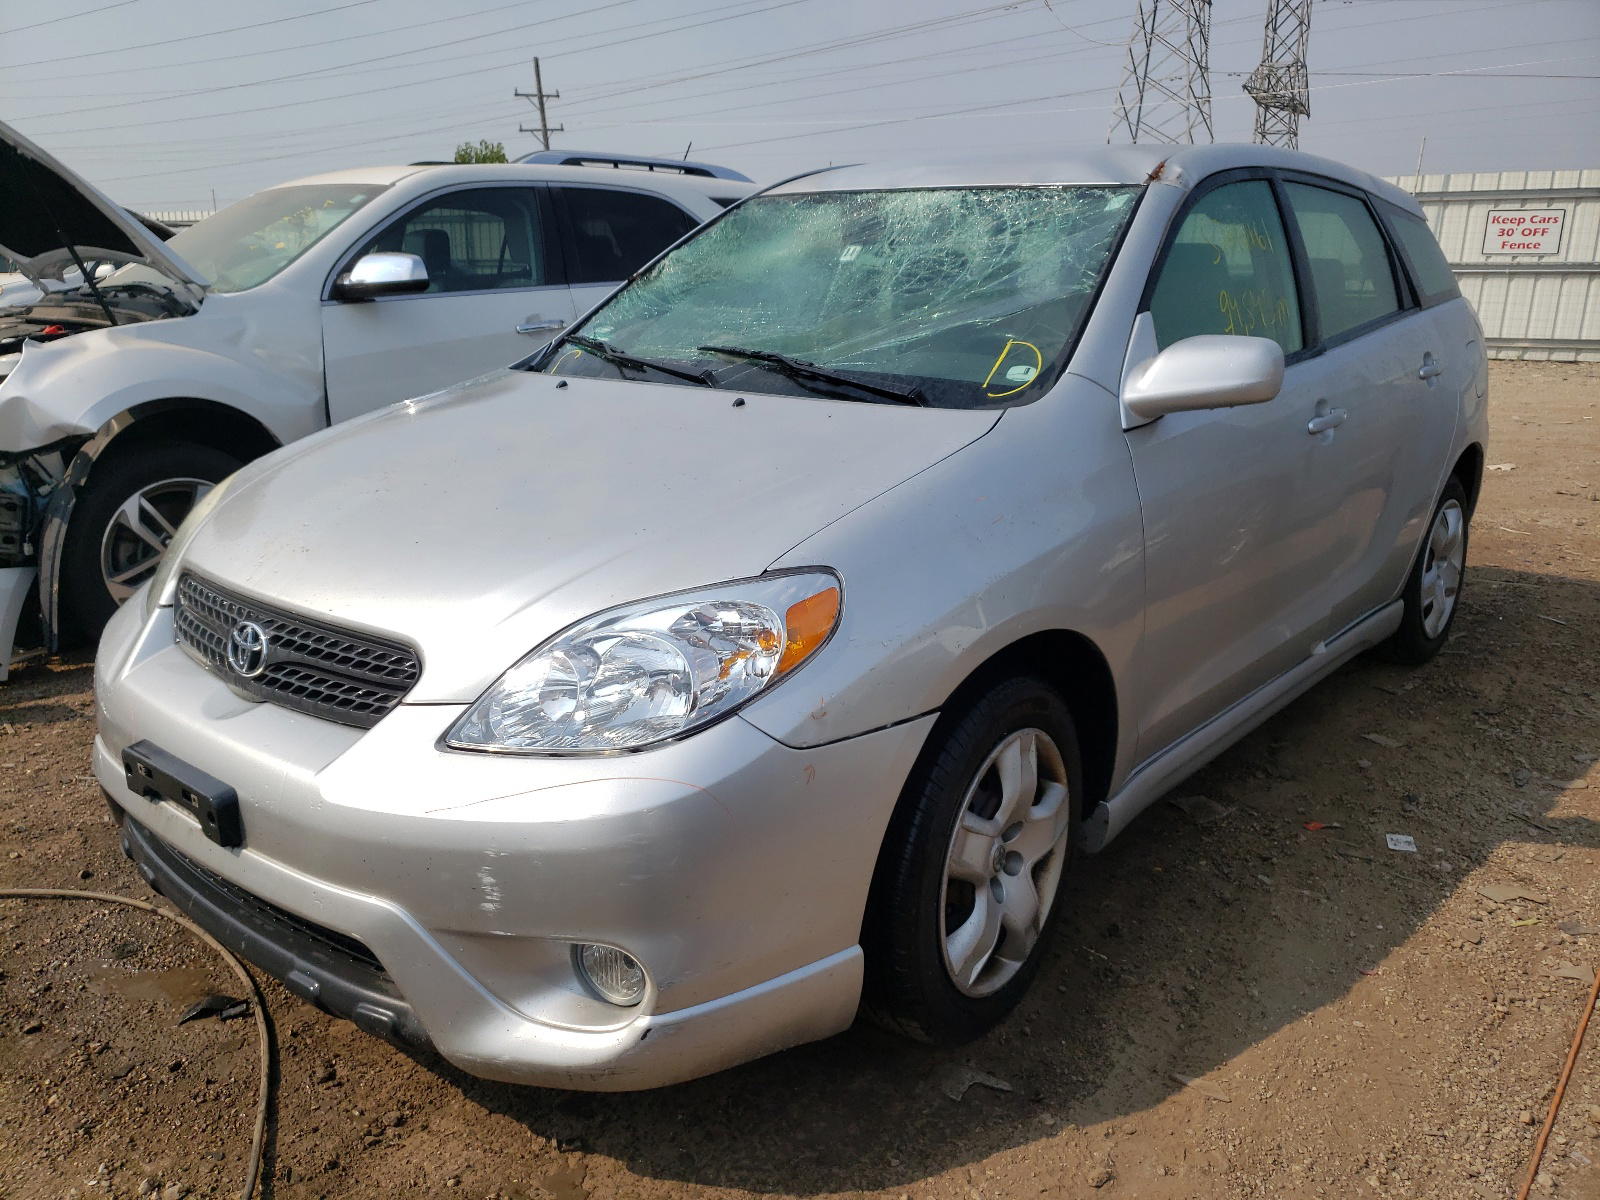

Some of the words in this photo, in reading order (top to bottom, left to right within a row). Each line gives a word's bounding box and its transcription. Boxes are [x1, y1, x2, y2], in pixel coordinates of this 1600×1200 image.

[1491, 215, 1526, 227] Keep
[1529, 215, 1559, 224] Cars
[1521, 228, 1549, 237] OFF
[1501, 241, 1541, 250] Fence
